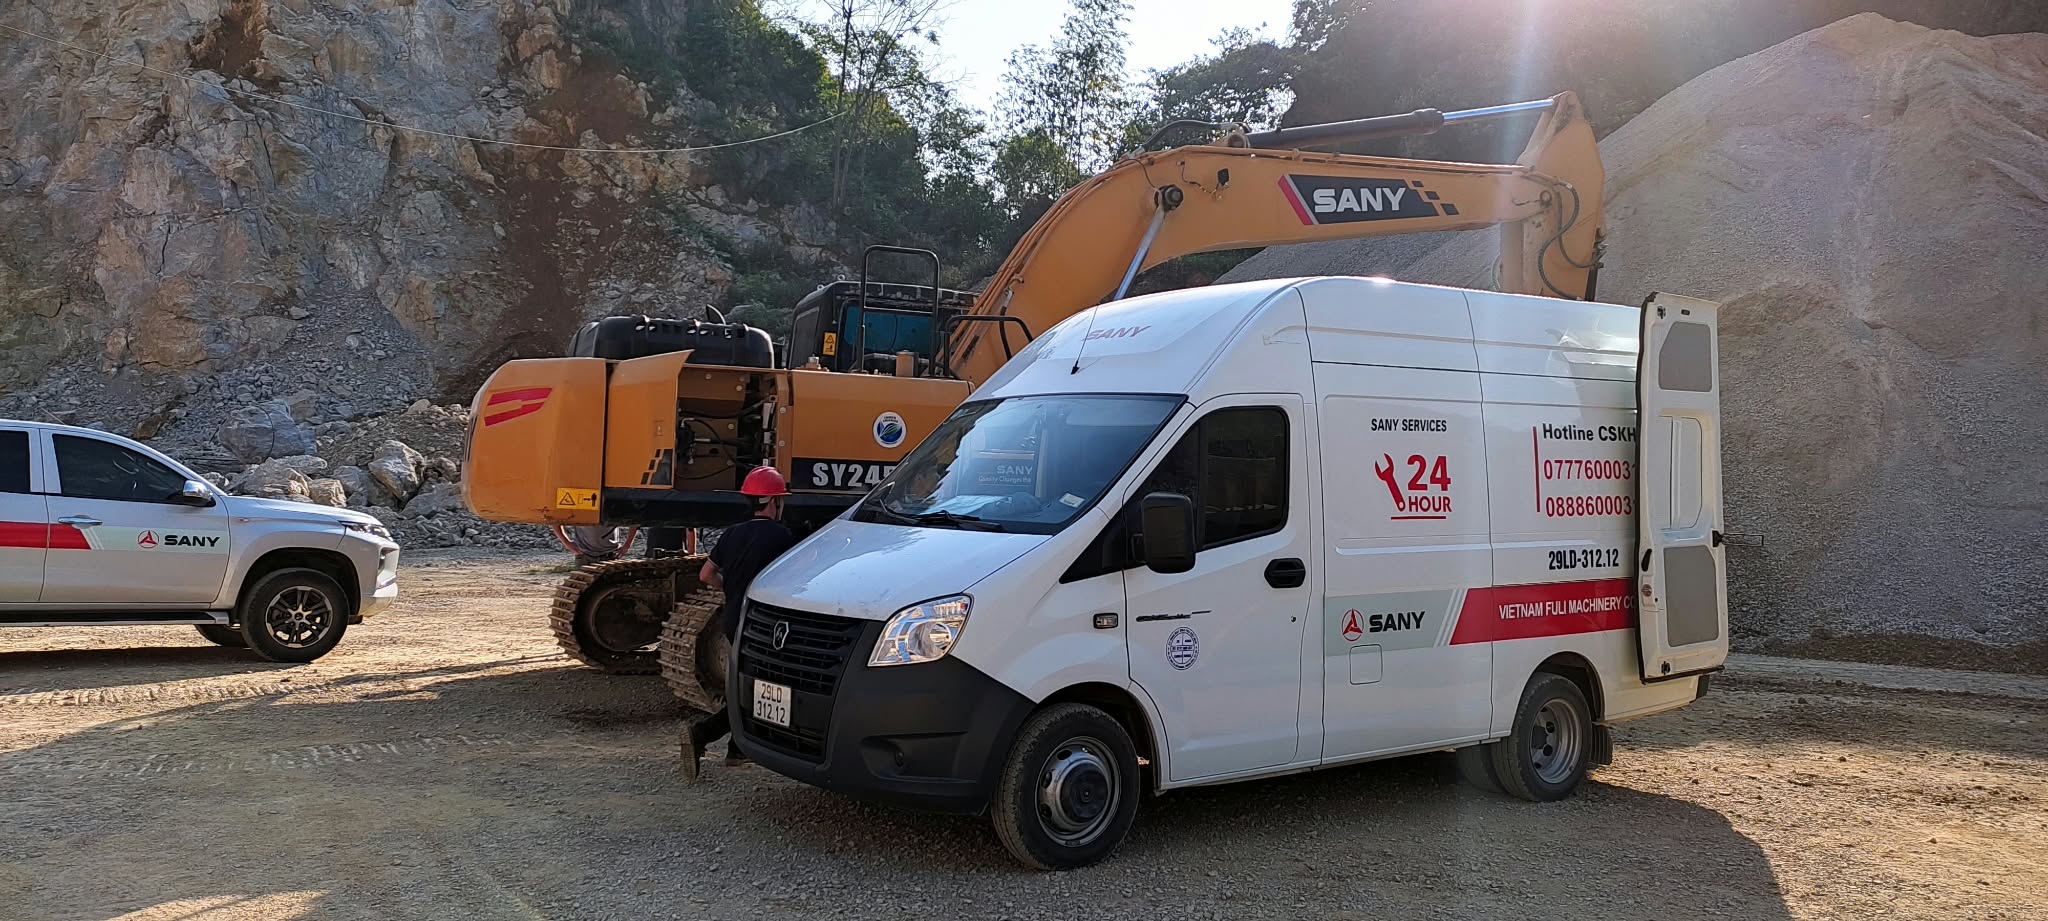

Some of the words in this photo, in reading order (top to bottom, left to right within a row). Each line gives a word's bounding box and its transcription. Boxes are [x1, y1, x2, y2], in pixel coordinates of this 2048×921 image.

[1313, 187, 1406, 213] SANY
[1081, 325, 1152, 341] SANY
[1371, 418, 1399, 431] SANY
[1402, 419, 1447, 432] SERVICES
[1542, 423, 1594, 441] Hotline
[1598, 425, 1636, 442] CSKH
[997, 465, 1033, 475] SANY
[1407, 454, 1451, 491] 24
[1543, 459, 1635, 480] 077760003
[1408, 495, 1452, 512] HOUR
[1545, 495, 1636, 517] 088860003
[164, 535, 220, 547] SANY
[1548, 548, 1620, 570] 29LD-312.12
[1498, 602, 1543, 619] VIETNAM
[1545, 600, 1567, 616] FULI
[1568, 596, 1622, 614] MACHINERY
[1369, 611, 1425, 633] SANY
[760, 683, 783, 703] 29LD
[756, 700, 786, 724] 312.12
